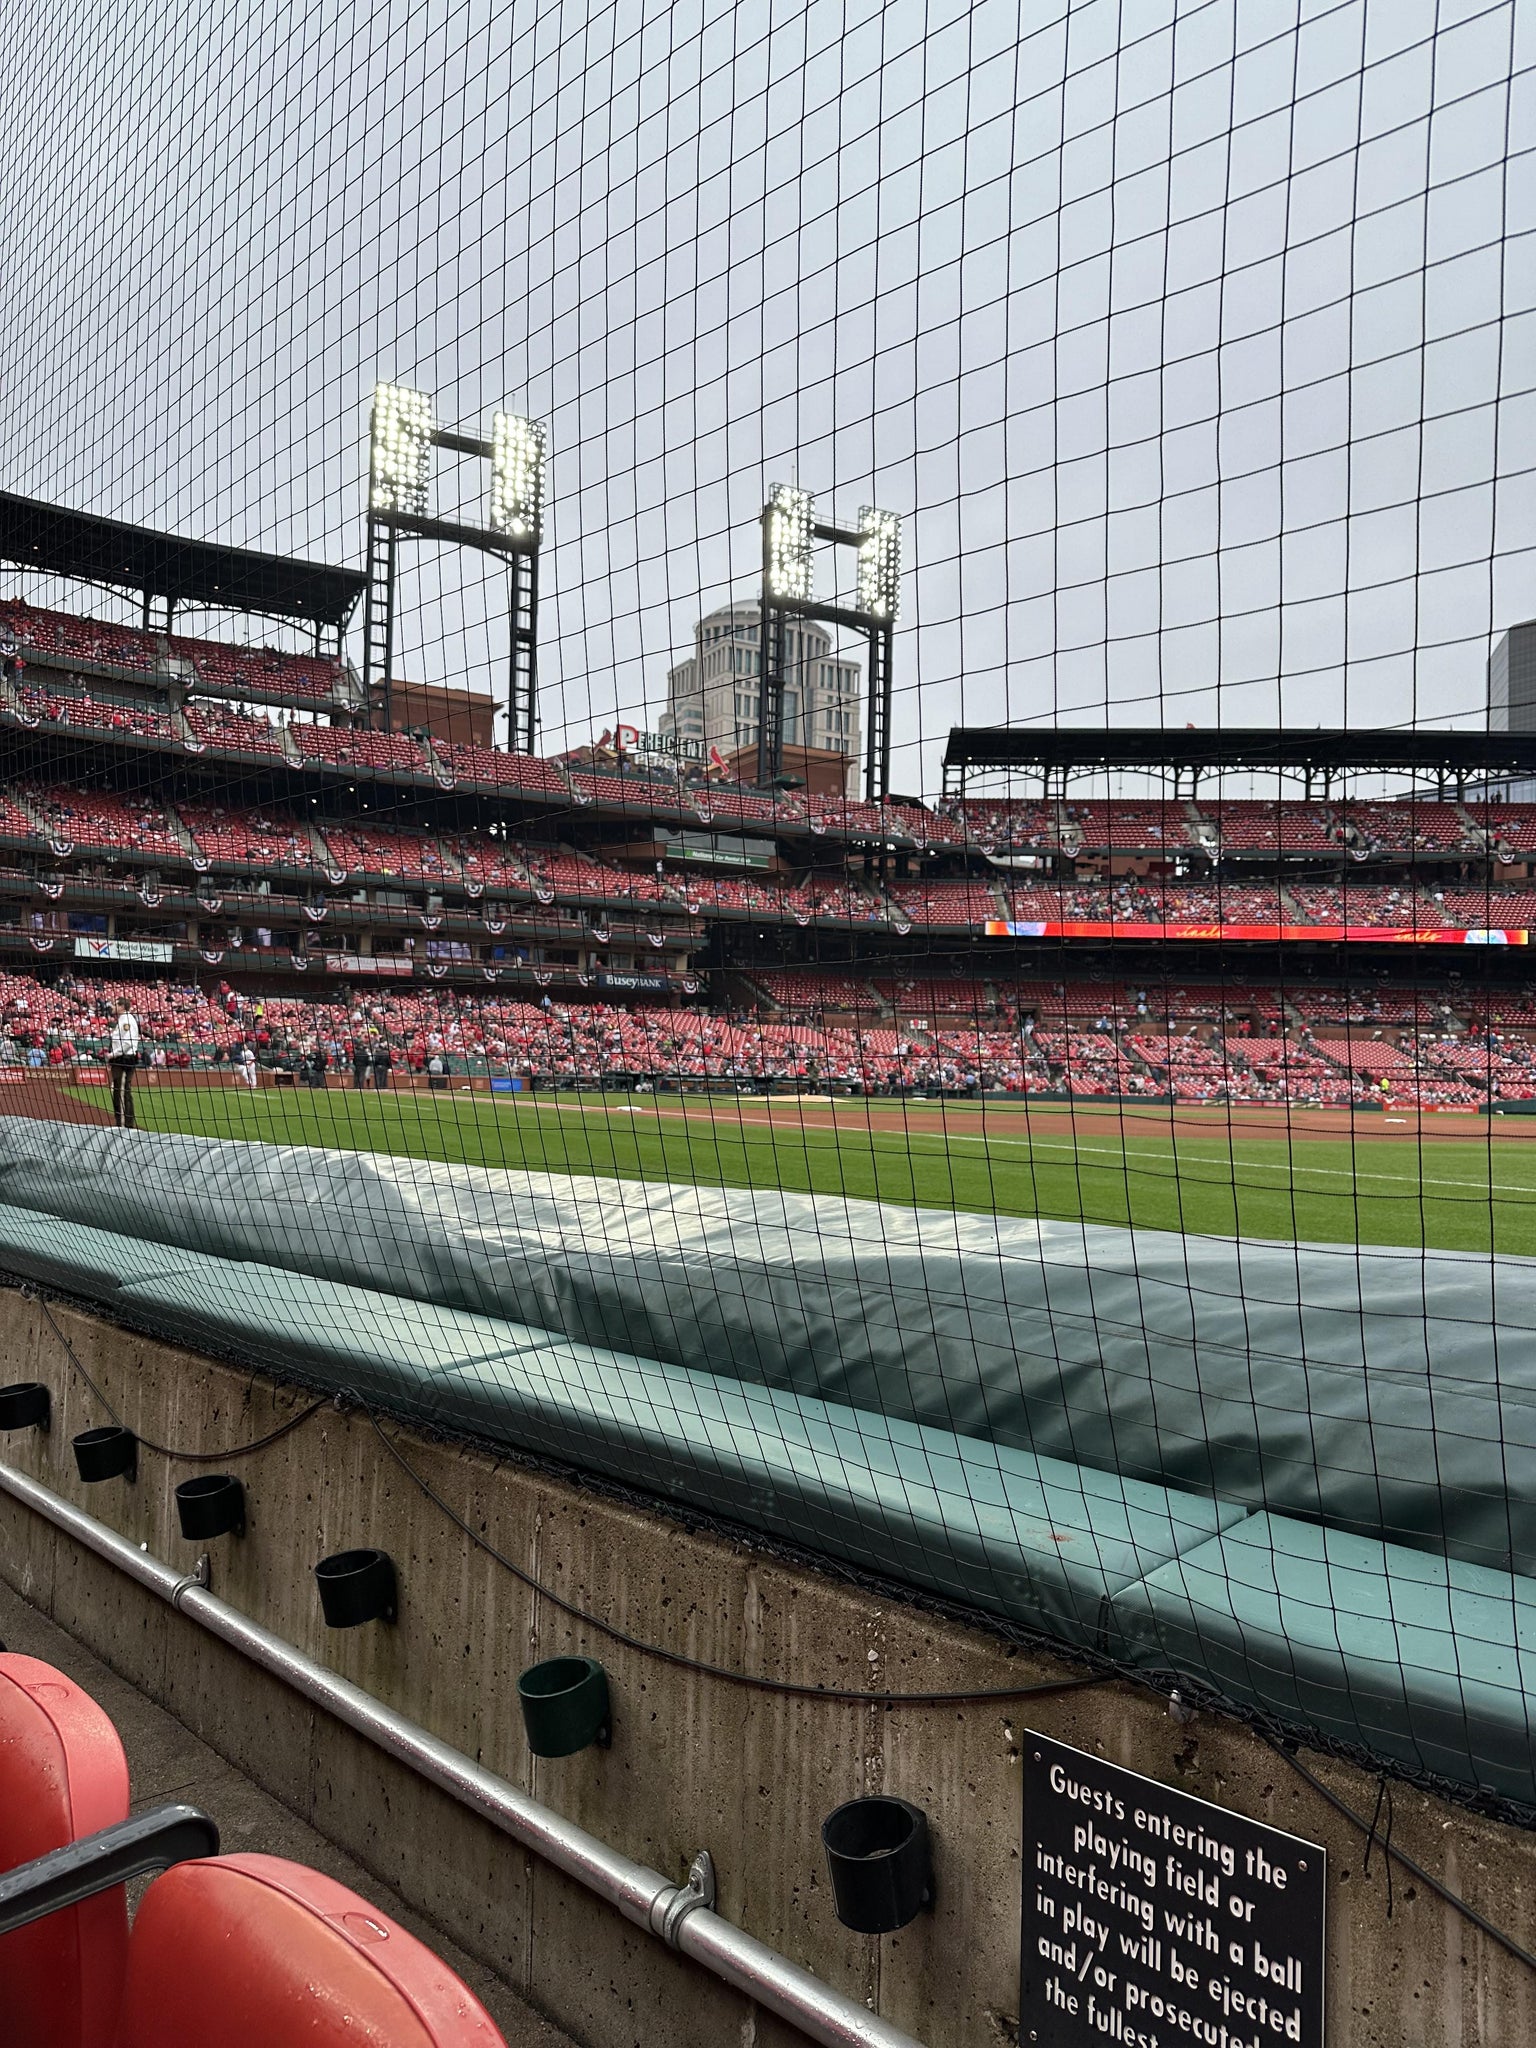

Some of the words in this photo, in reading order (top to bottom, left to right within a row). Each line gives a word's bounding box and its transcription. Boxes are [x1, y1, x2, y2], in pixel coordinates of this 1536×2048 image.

[634, 752, 686, 771] PERCH
[692, 851, 714, 859] Nationa
[1050, 1764, 1125, 1820] Guests
[1134, 1809, 1235, 1877] entering
[1245, 1847, 1287, 1890] the
[1074, 1820, 1156, 1888] playing
[1166, 1855, 1219, 1908] field
[1229, 1896, 1256, 1923] or
[1036, 1842, 1154, 1932] interfering
[1164, 1910, 1219, 1955] with
[1229, 1942, 1244, 1966] a
[1254, 1941, 1302, 1994] ball
[1036, 1884, 1055, 1918] in
[1063, 1902, 1110, 1952] play
[1119, 1933, 1161, 1972] will
[1170, 1948, 1199, 1990] be
[1208, 1975, 1301, 2043] ejected
[1038, 1937, 1118, 1992] and/or
[1045, 1976, 1079, 2016] the
[1087, 1995, 1159, 2048] fullest
